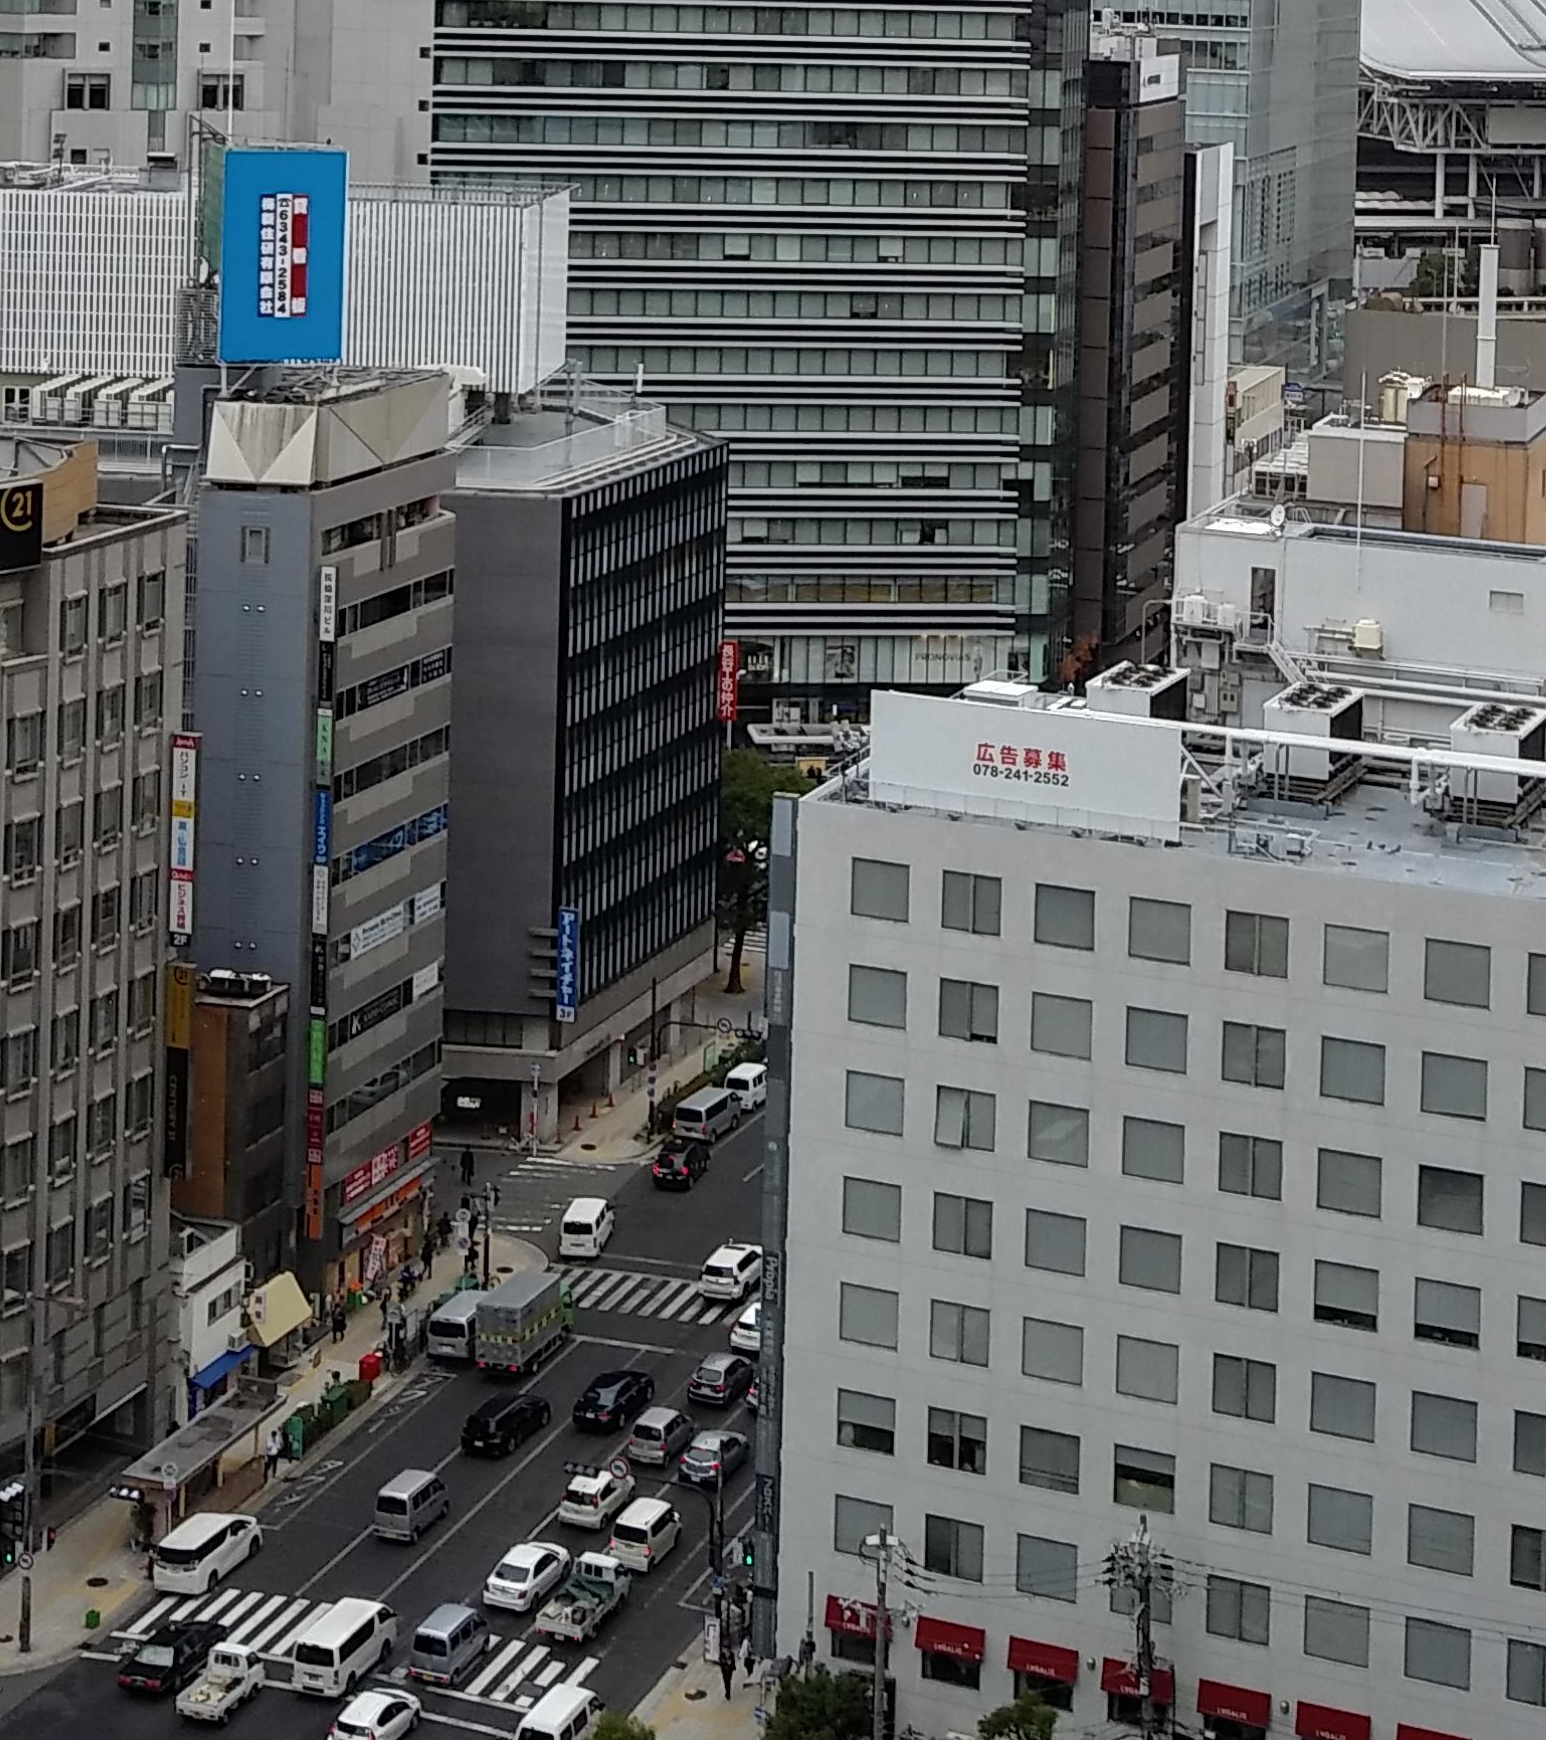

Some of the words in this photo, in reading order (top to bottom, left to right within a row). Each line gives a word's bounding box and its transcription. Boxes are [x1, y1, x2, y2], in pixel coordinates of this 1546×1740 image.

[720, 644, 735, 717] 長谷工の仲介
[976, 742, 1067, 772] 広告募集
[973, 763, 1070, 787] 078-241-2552
[173, 933, 188, 946] 2F
